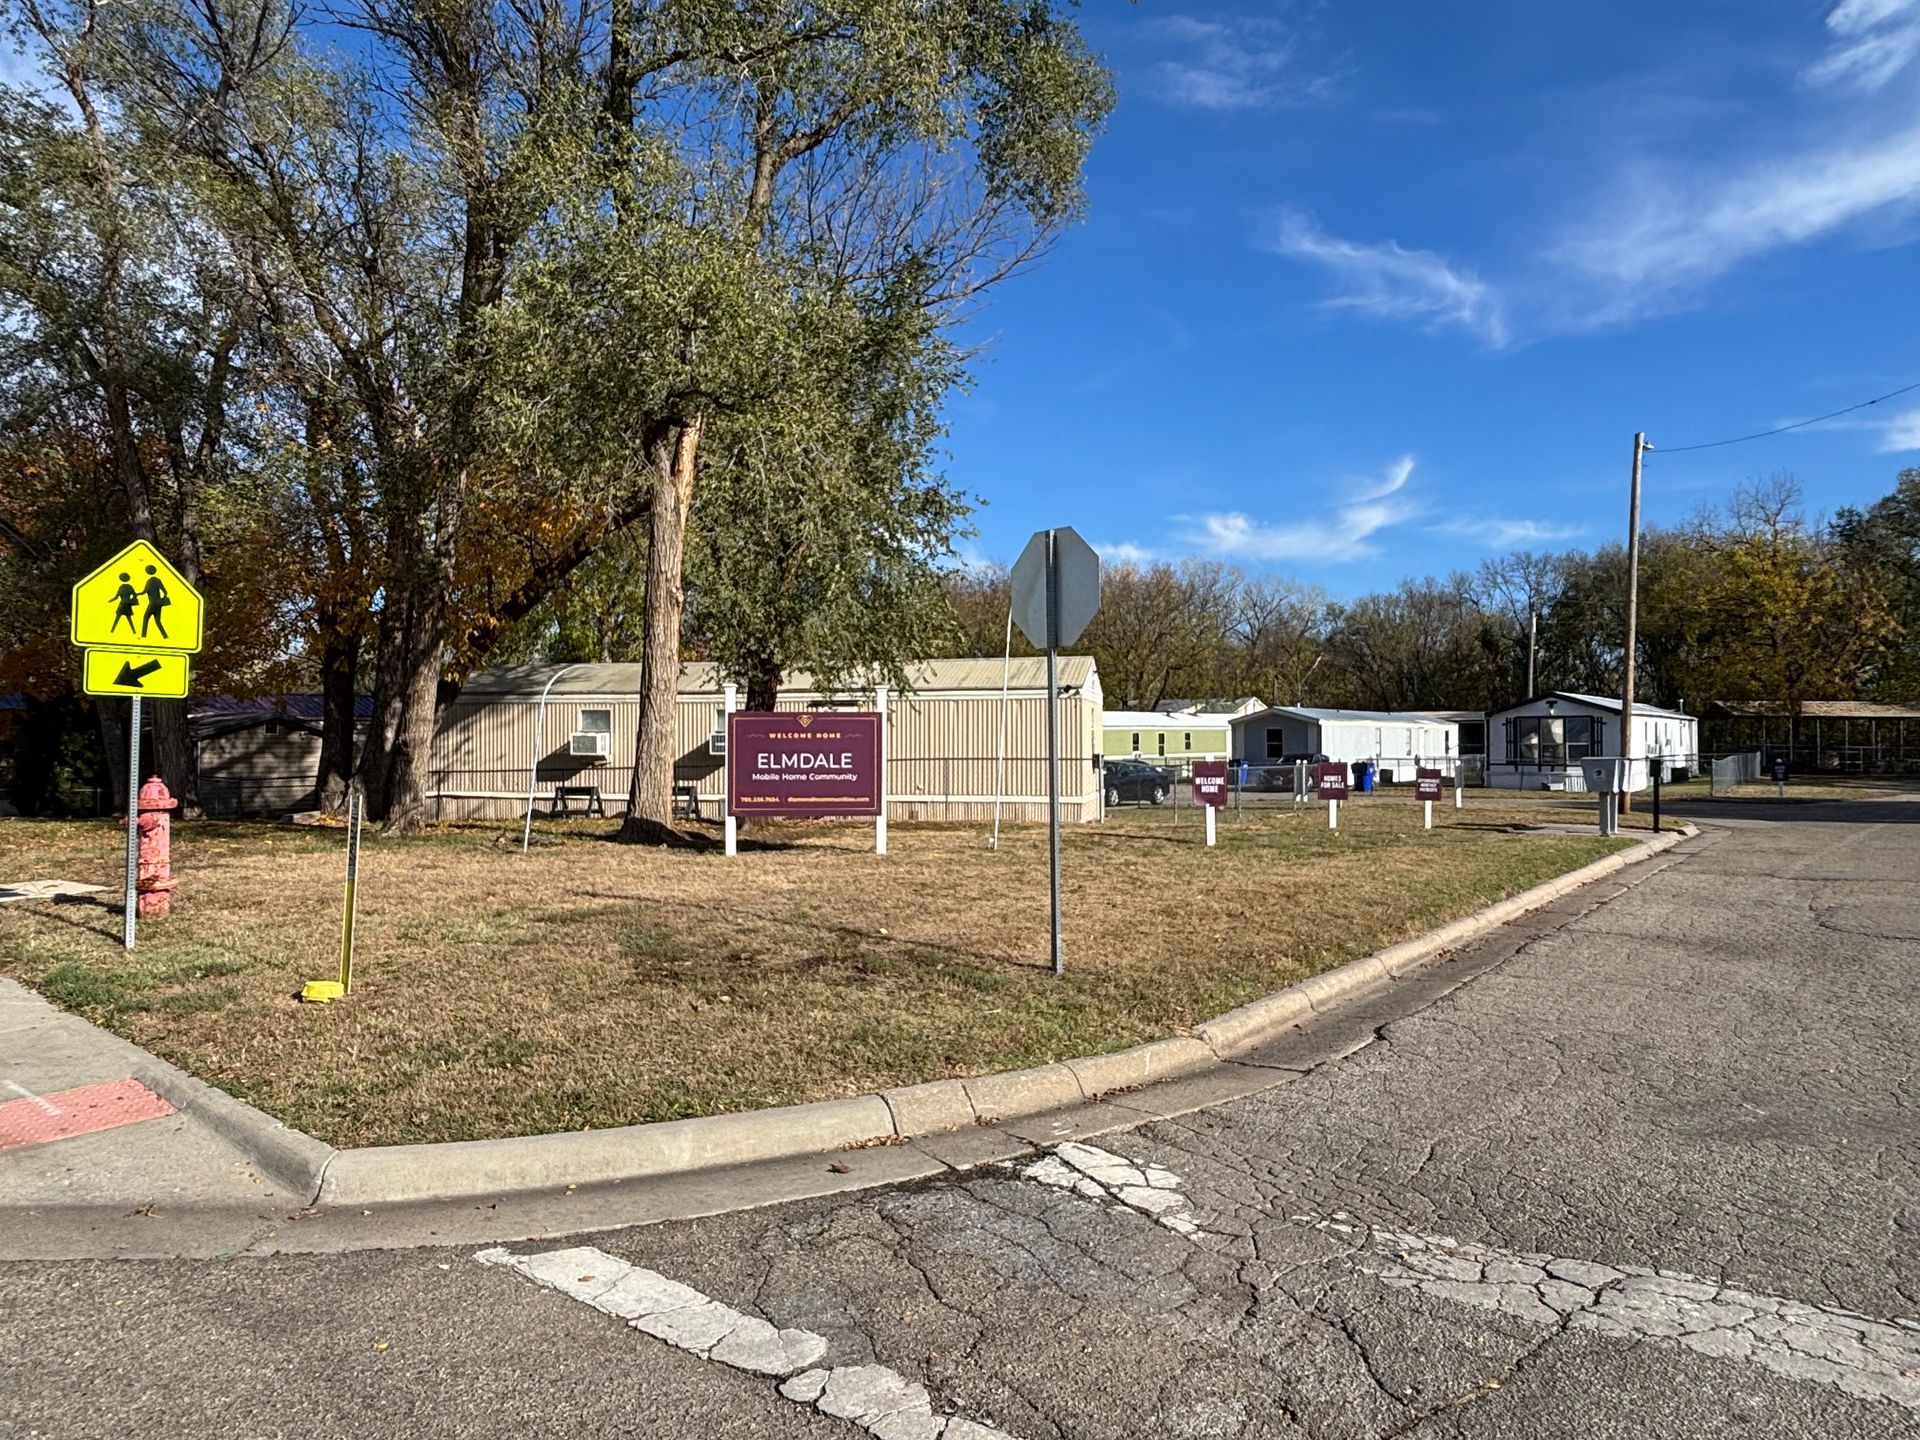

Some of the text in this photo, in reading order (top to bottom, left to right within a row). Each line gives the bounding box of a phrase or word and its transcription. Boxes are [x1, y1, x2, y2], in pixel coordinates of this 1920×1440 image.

[757, 753, 853, 769] ELMDALE
[752, 773, 858, 782] Mobile Home Community
[1195, 777, 1224, 785] WELCOME
[1201, 785, 1219, 793] HOME
